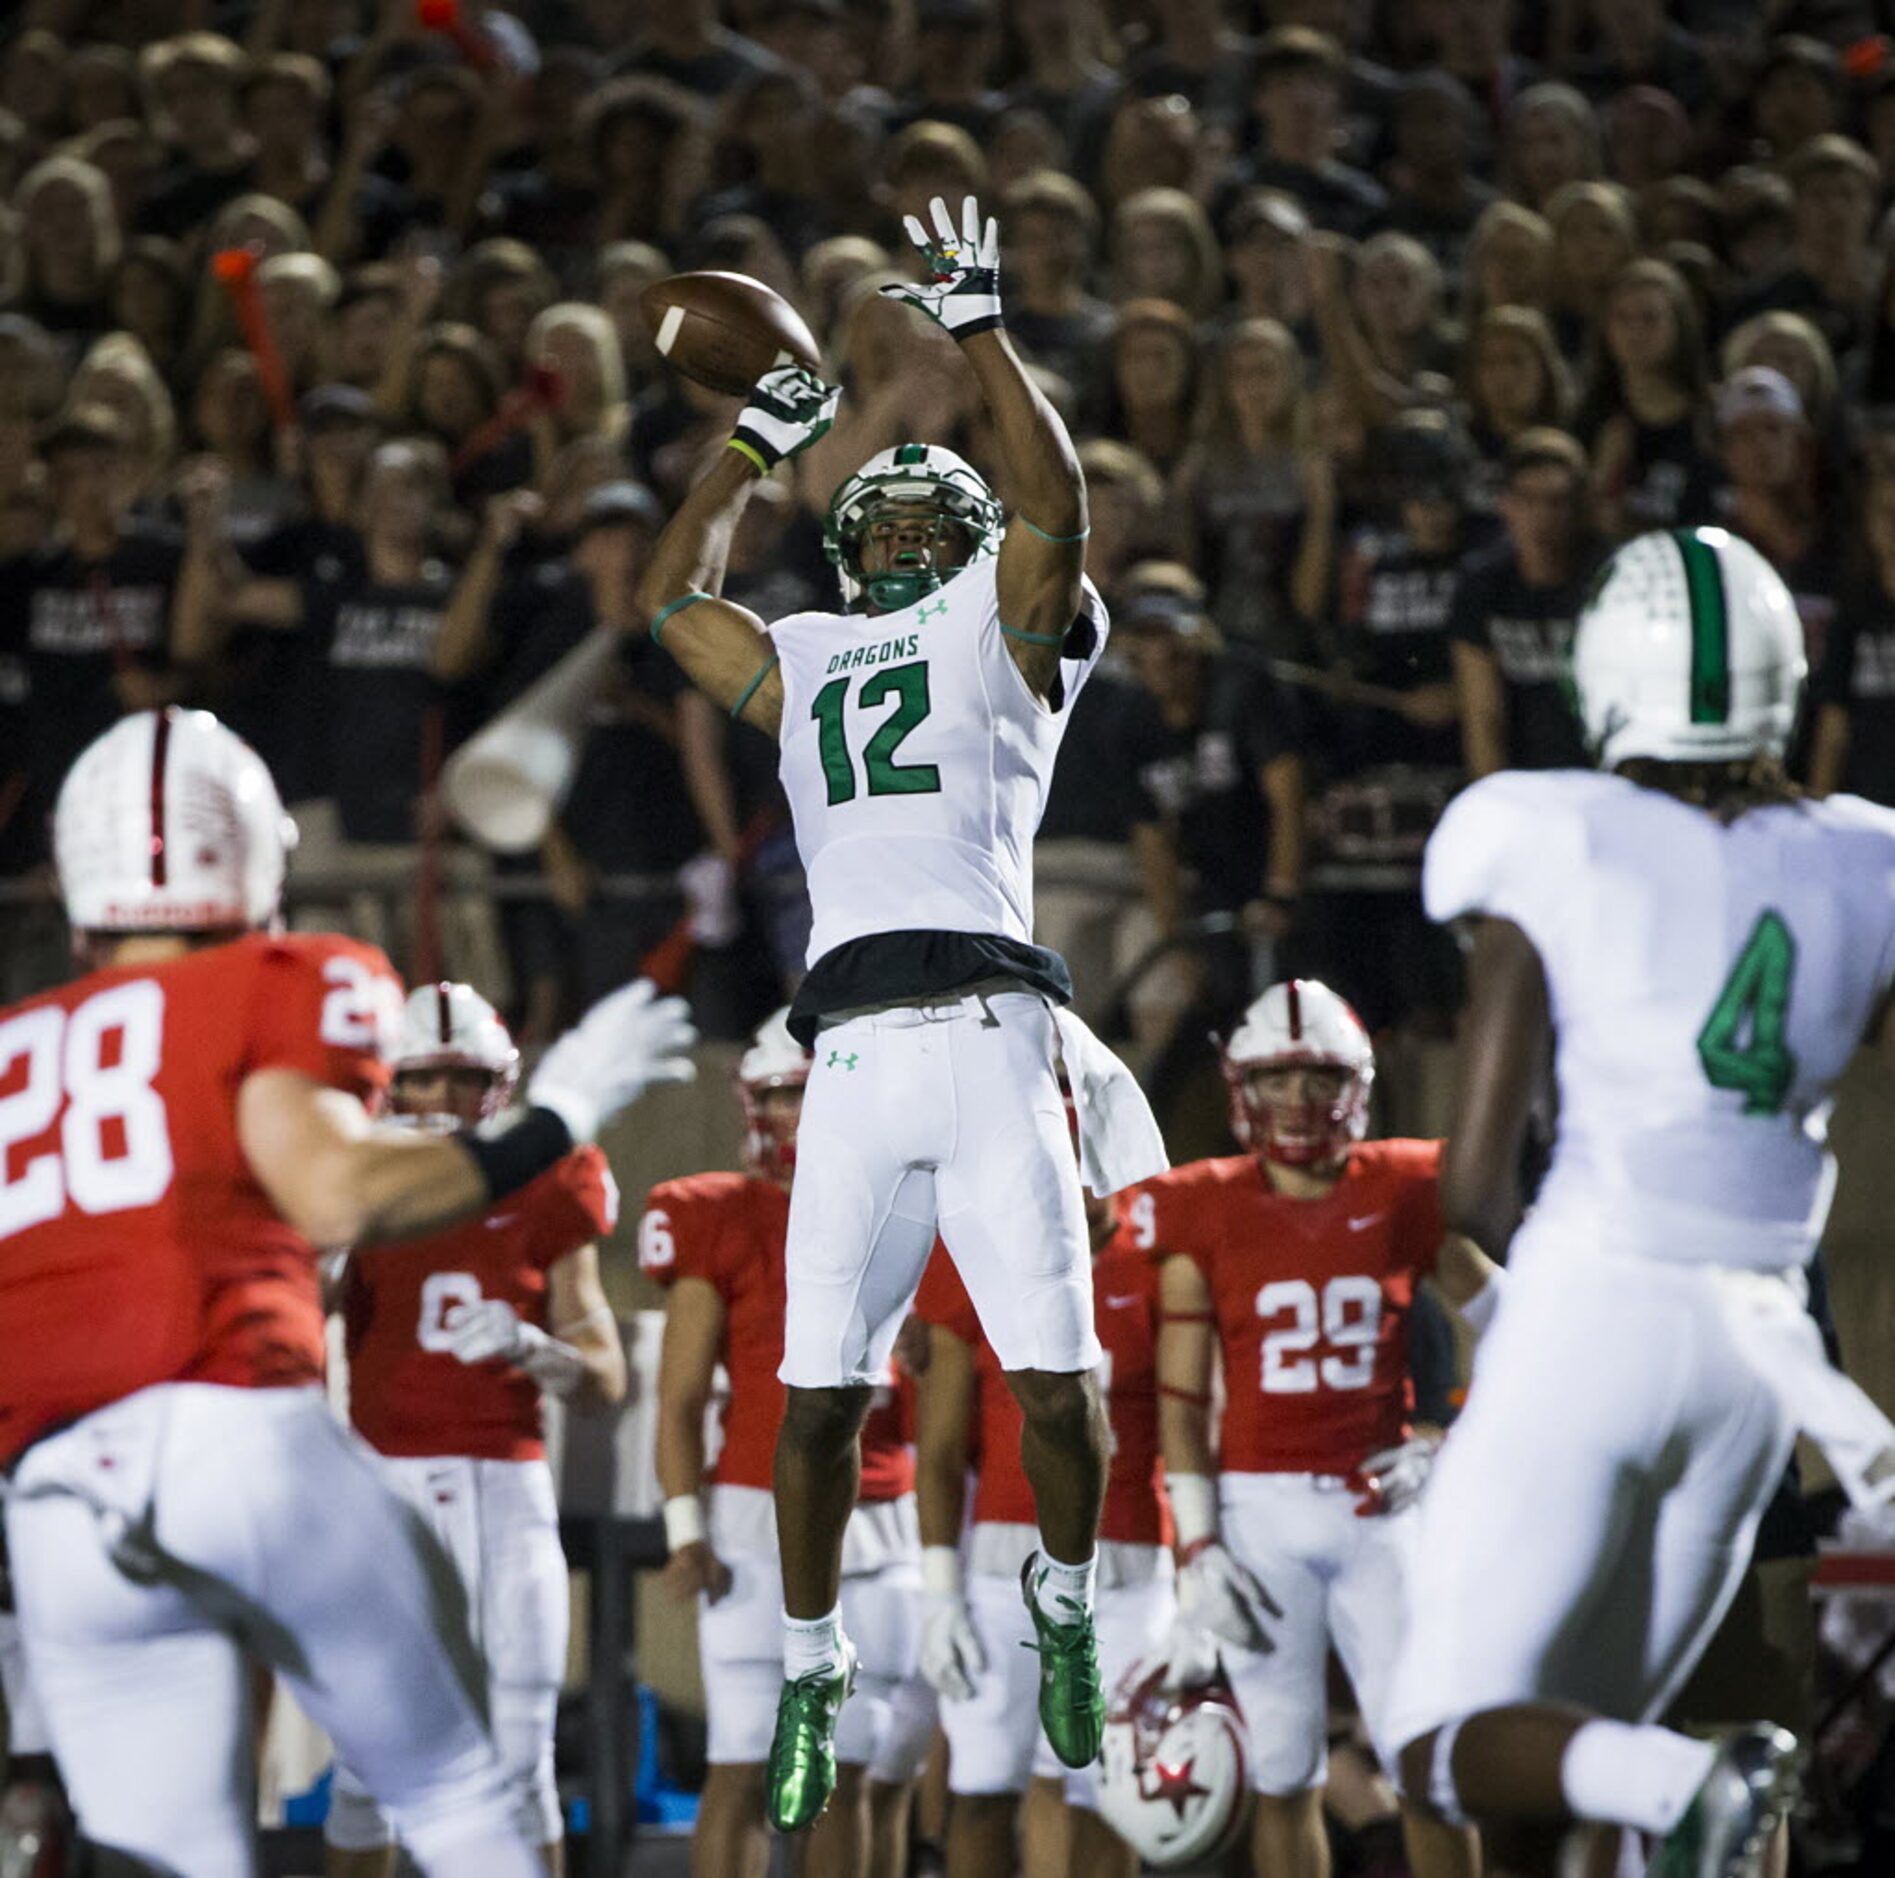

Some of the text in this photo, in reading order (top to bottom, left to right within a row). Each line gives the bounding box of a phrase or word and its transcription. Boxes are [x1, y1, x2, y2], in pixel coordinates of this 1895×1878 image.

[827, 634, 919, 674] DRAGONS
[811, 660, 942, 807] 12
[1696, 908, 1799, 1115] 4
[0, 978, 175, 1240] 28
[1255, 1275, 1382, 1393] 29
